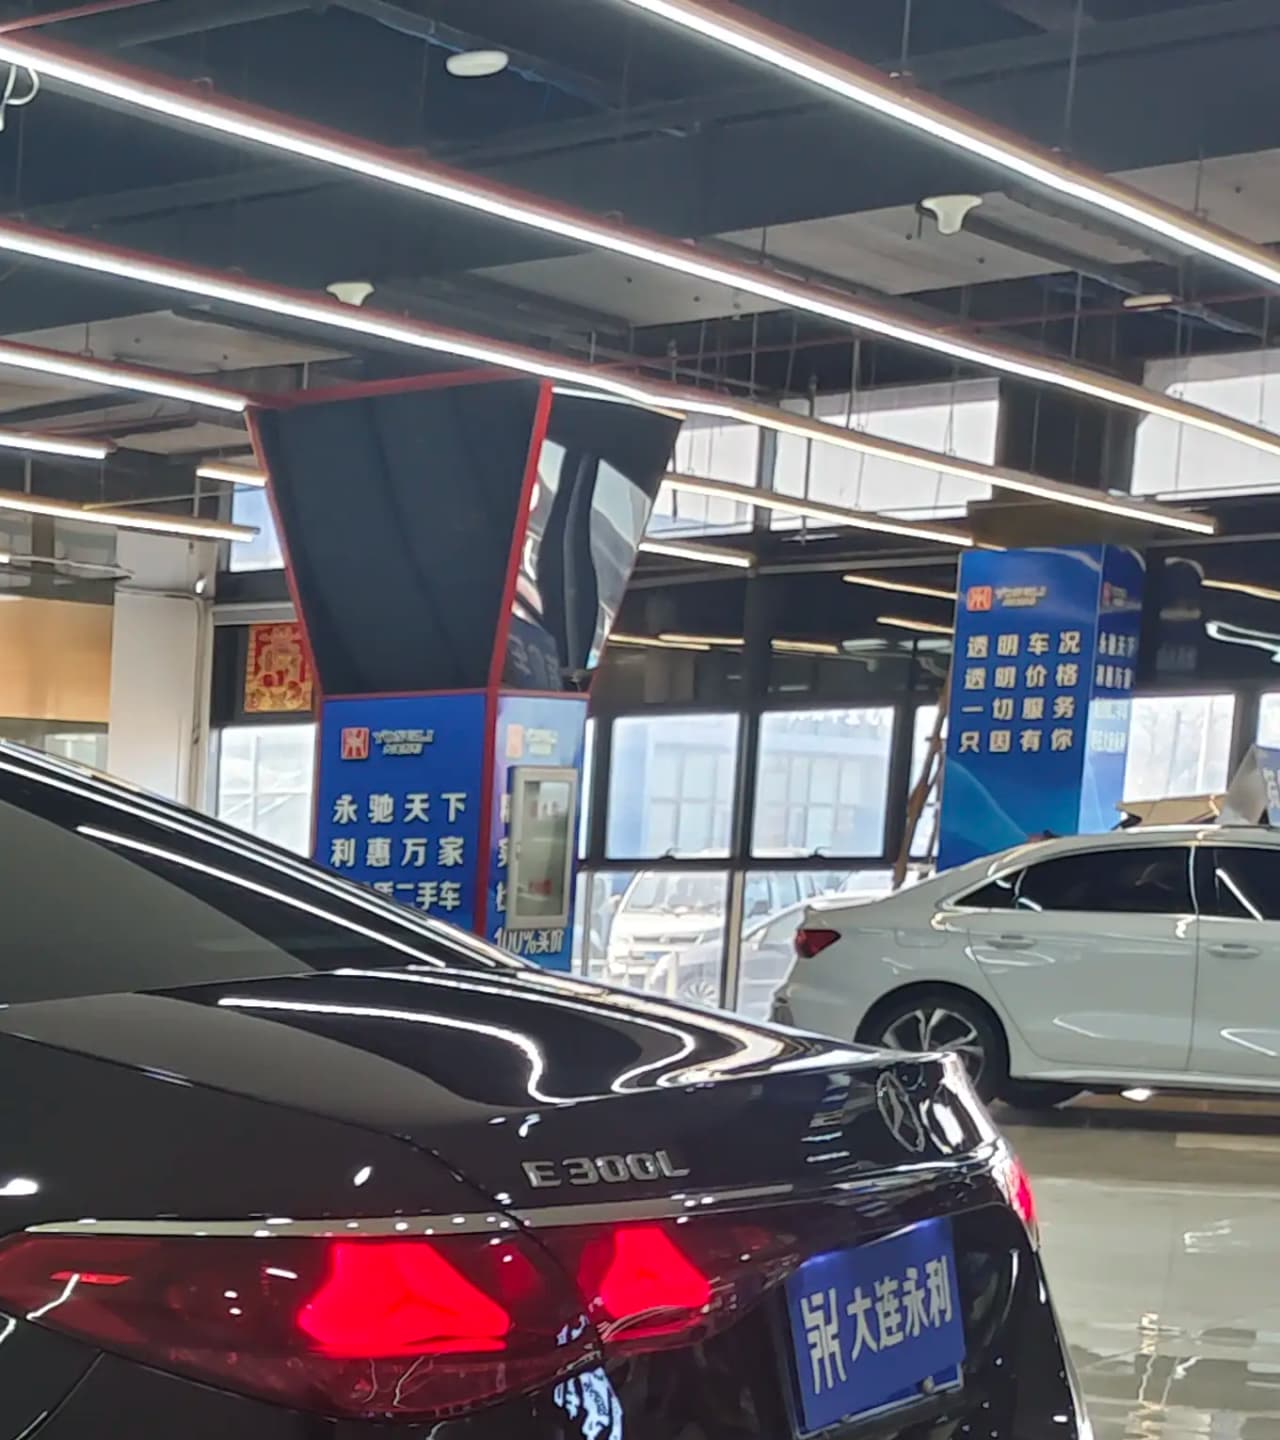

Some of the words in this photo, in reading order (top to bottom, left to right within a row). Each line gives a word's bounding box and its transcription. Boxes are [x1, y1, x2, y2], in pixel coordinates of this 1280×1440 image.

[966, 631, 1082, 659] 透明车况
[963, 663, 1079, 690] 透明价格
[960, 695, 1076, 721] 一切服务
[958, 727, 1074, 754] 只因有你
[332, 792, 468, 825] 永驰天下
[329, 836, 466, 869] 利惠万家
[846, 1254, 953, 1364] 大连永利
